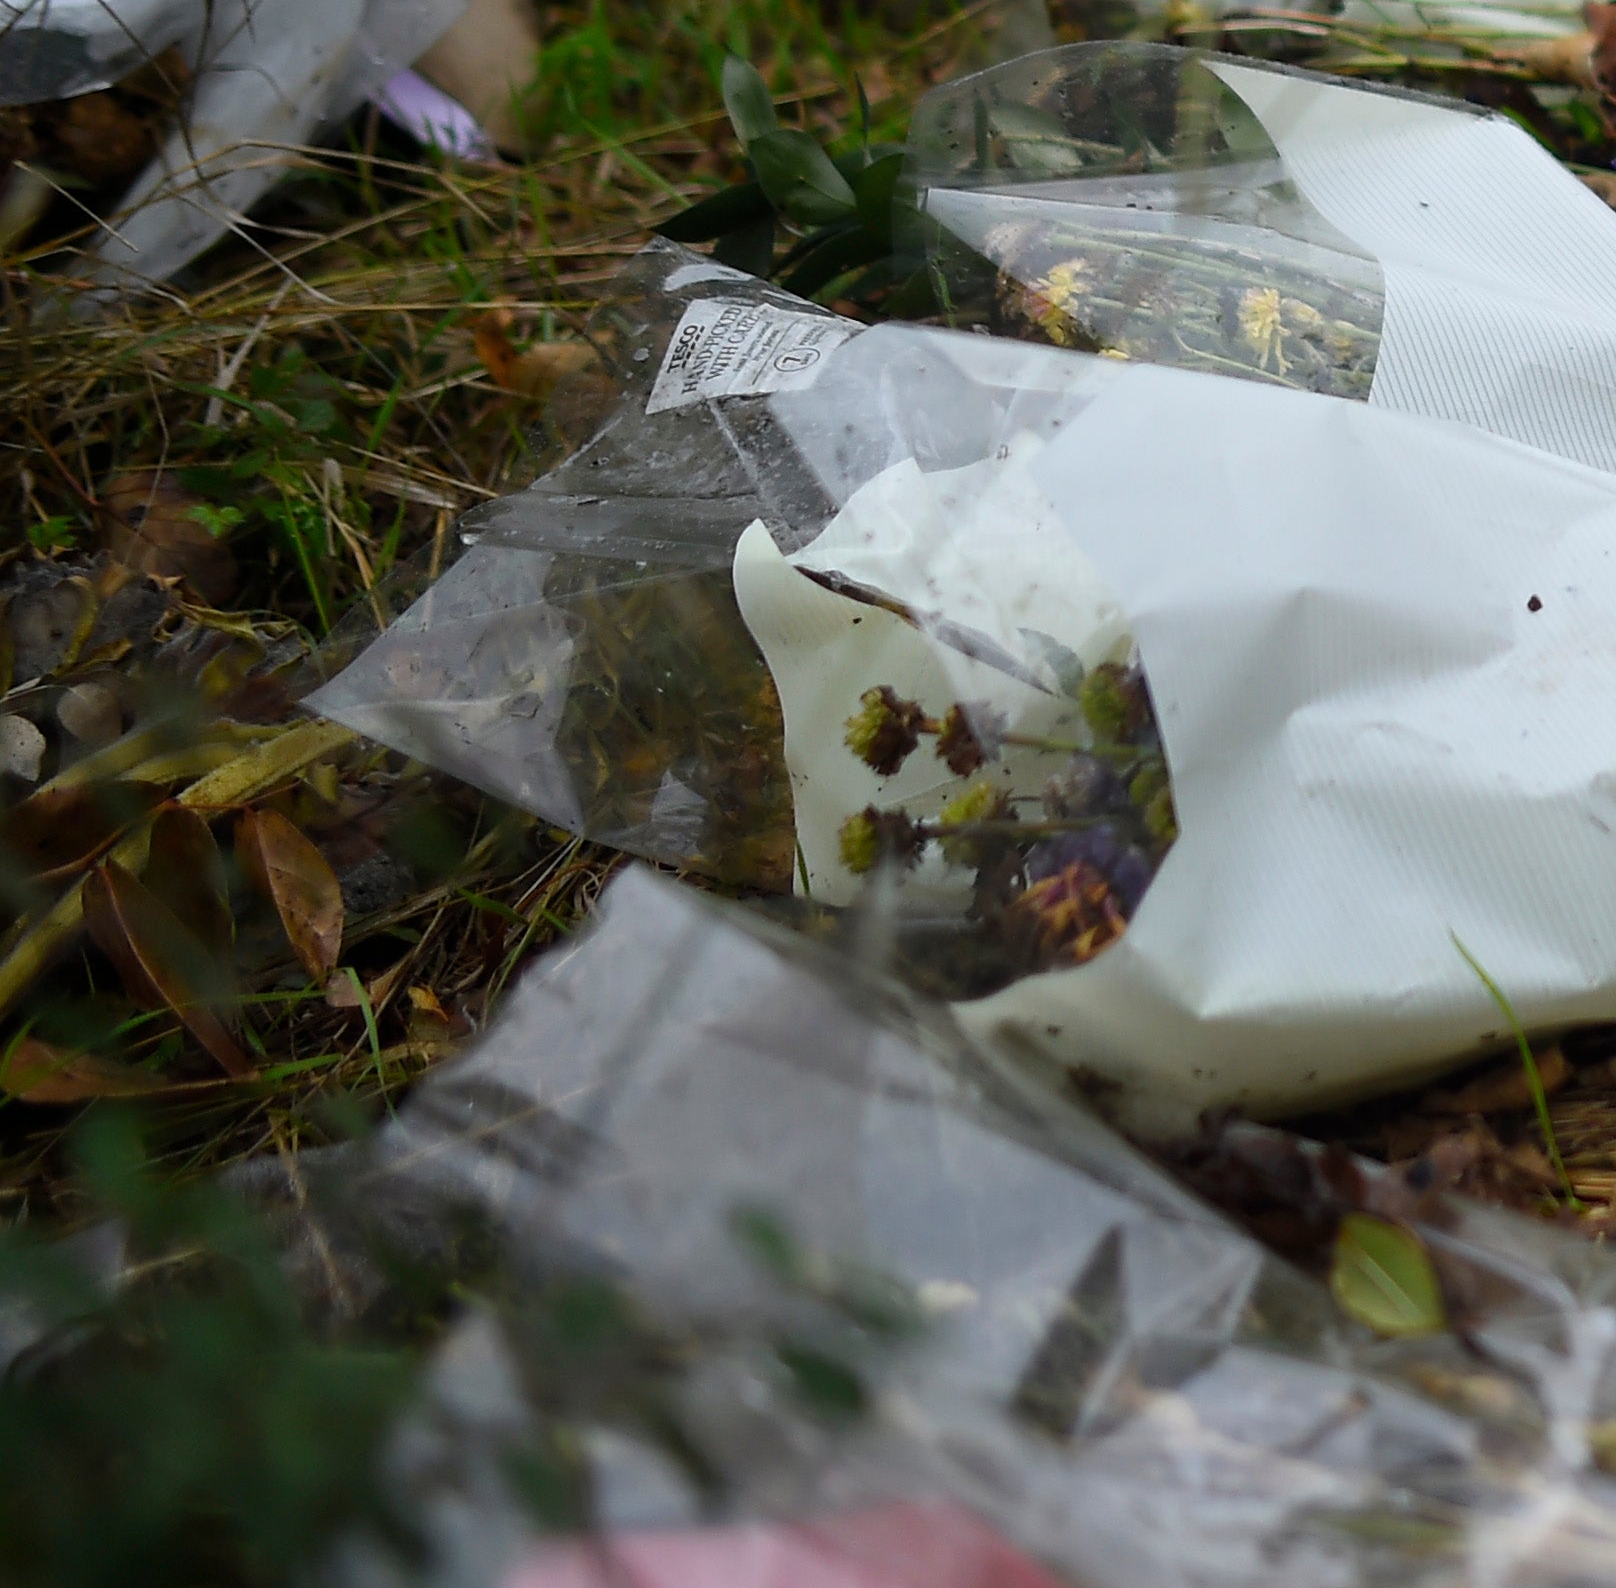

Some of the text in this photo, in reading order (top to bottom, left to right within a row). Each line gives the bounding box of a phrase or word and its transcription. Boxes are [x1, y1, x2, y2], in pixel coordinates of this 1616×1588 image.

[667, 324, 698, 373] TESCO
[681, 307, 742, 394] HAND-PICKED
[705, 346, 739, 381] WITH
[781, 356, 801, 364] 7
